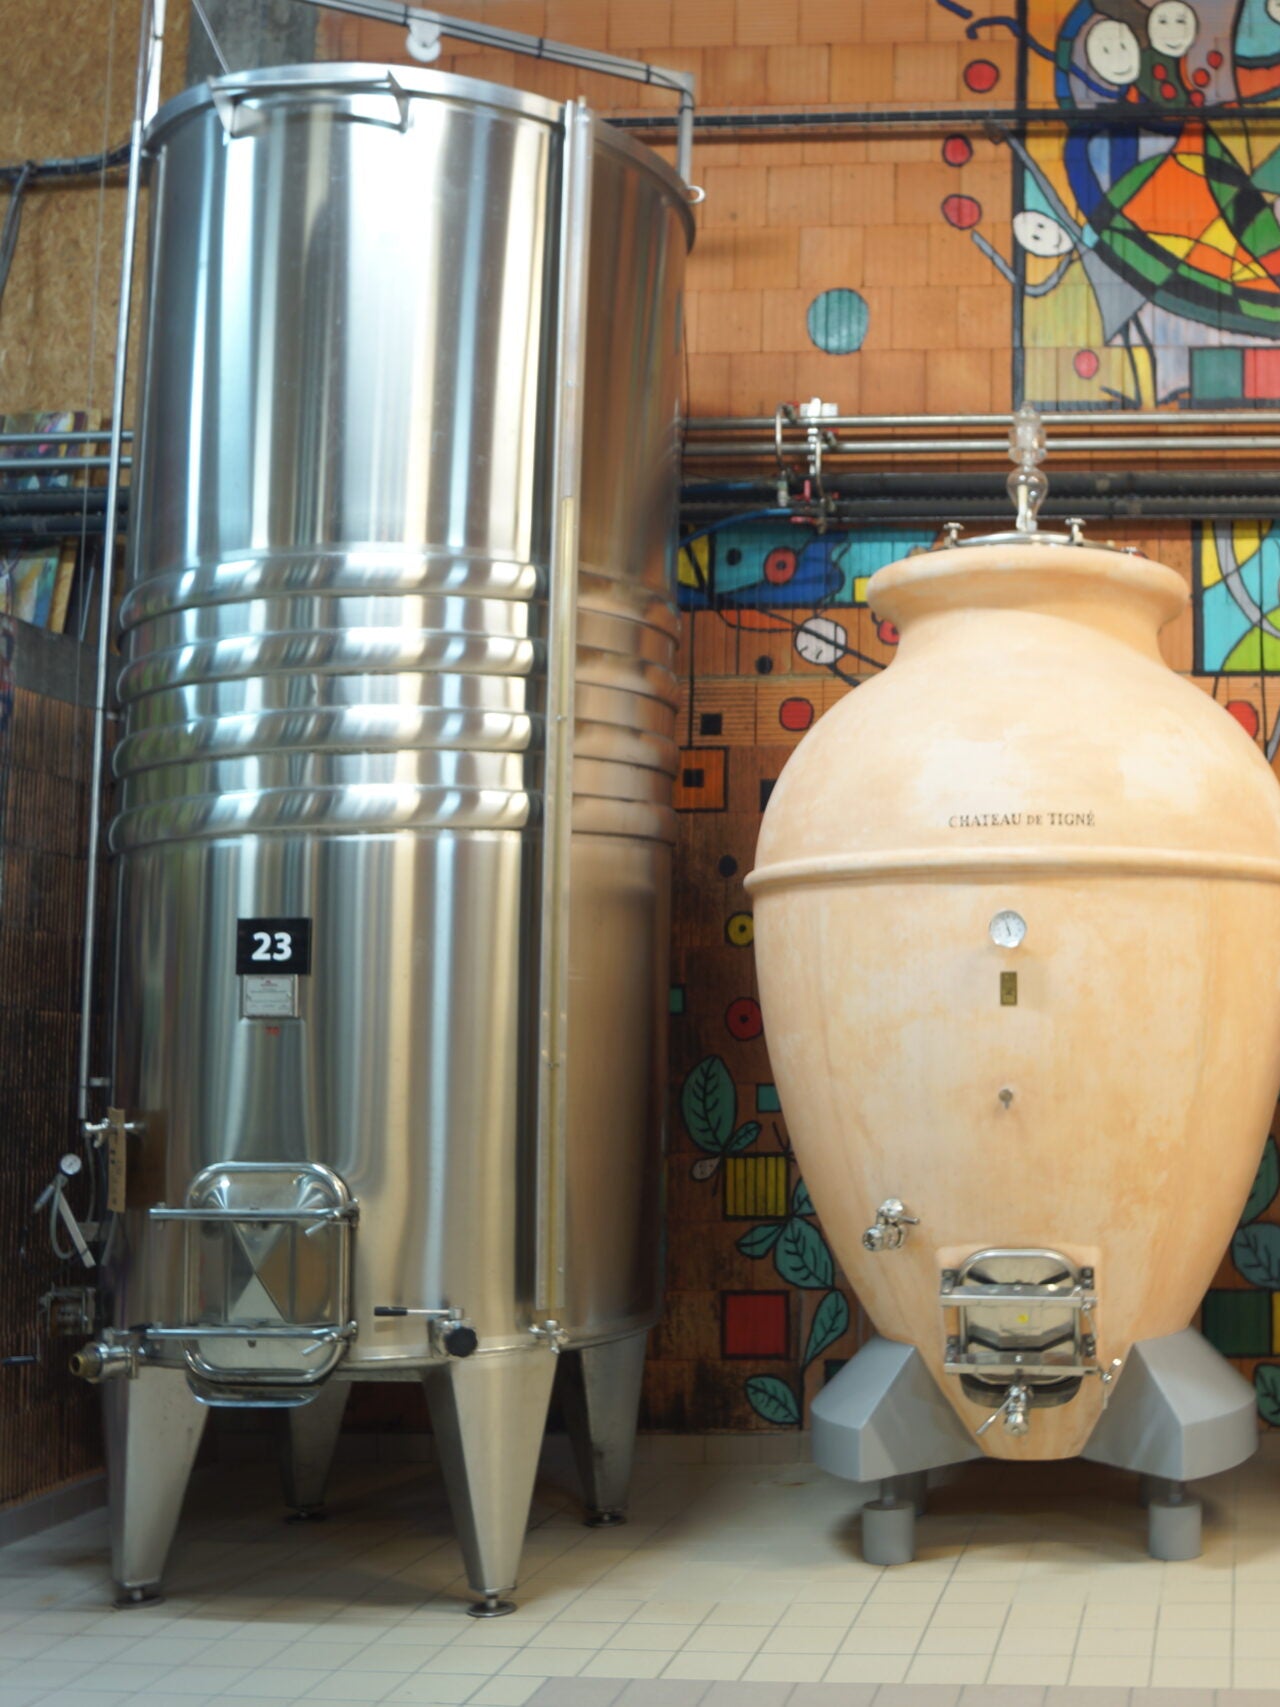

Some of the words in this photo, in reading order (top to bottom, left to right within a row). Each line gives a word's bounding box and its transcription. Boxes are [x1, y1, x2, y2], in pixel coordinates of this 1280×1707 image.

[948, 813, 1022, 829] CHATEAU
[1048, 810, 1096, 827] TIGNÉ
[251, 931, 292, 961] 23
